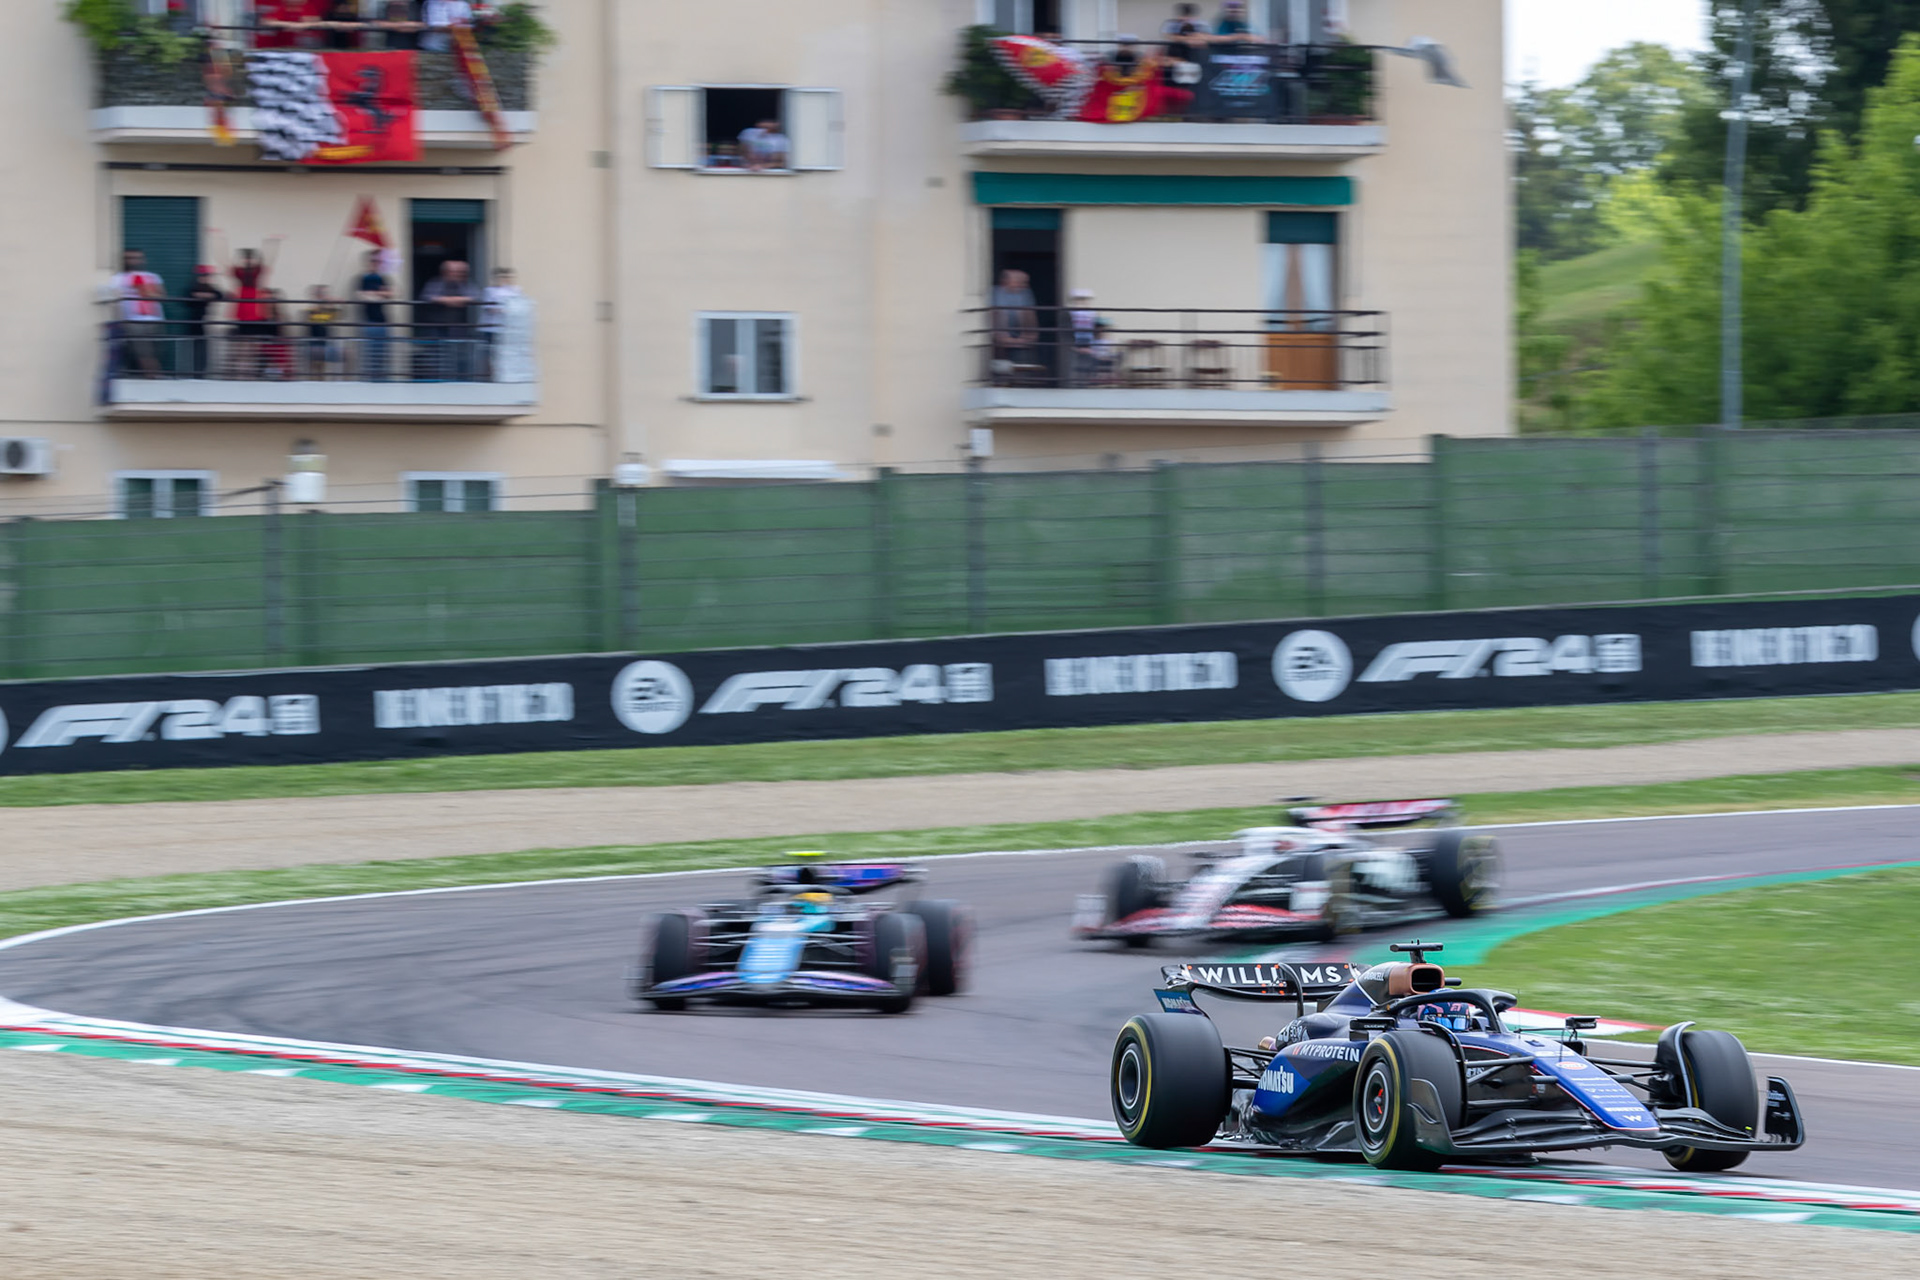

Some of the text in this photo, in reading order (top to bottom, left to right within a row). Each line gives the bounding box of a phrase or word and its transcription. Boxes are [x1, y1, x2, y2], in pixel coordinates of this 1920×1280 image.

[1493, 635, 1594, 676] 24
[839, 664, 944, 706] 24
[161, 695, 270, 739] 24
[1198, 966, 1342, 985] WILLIMS
[1300, 1044, 1360, 1062] MYPROTEIN
